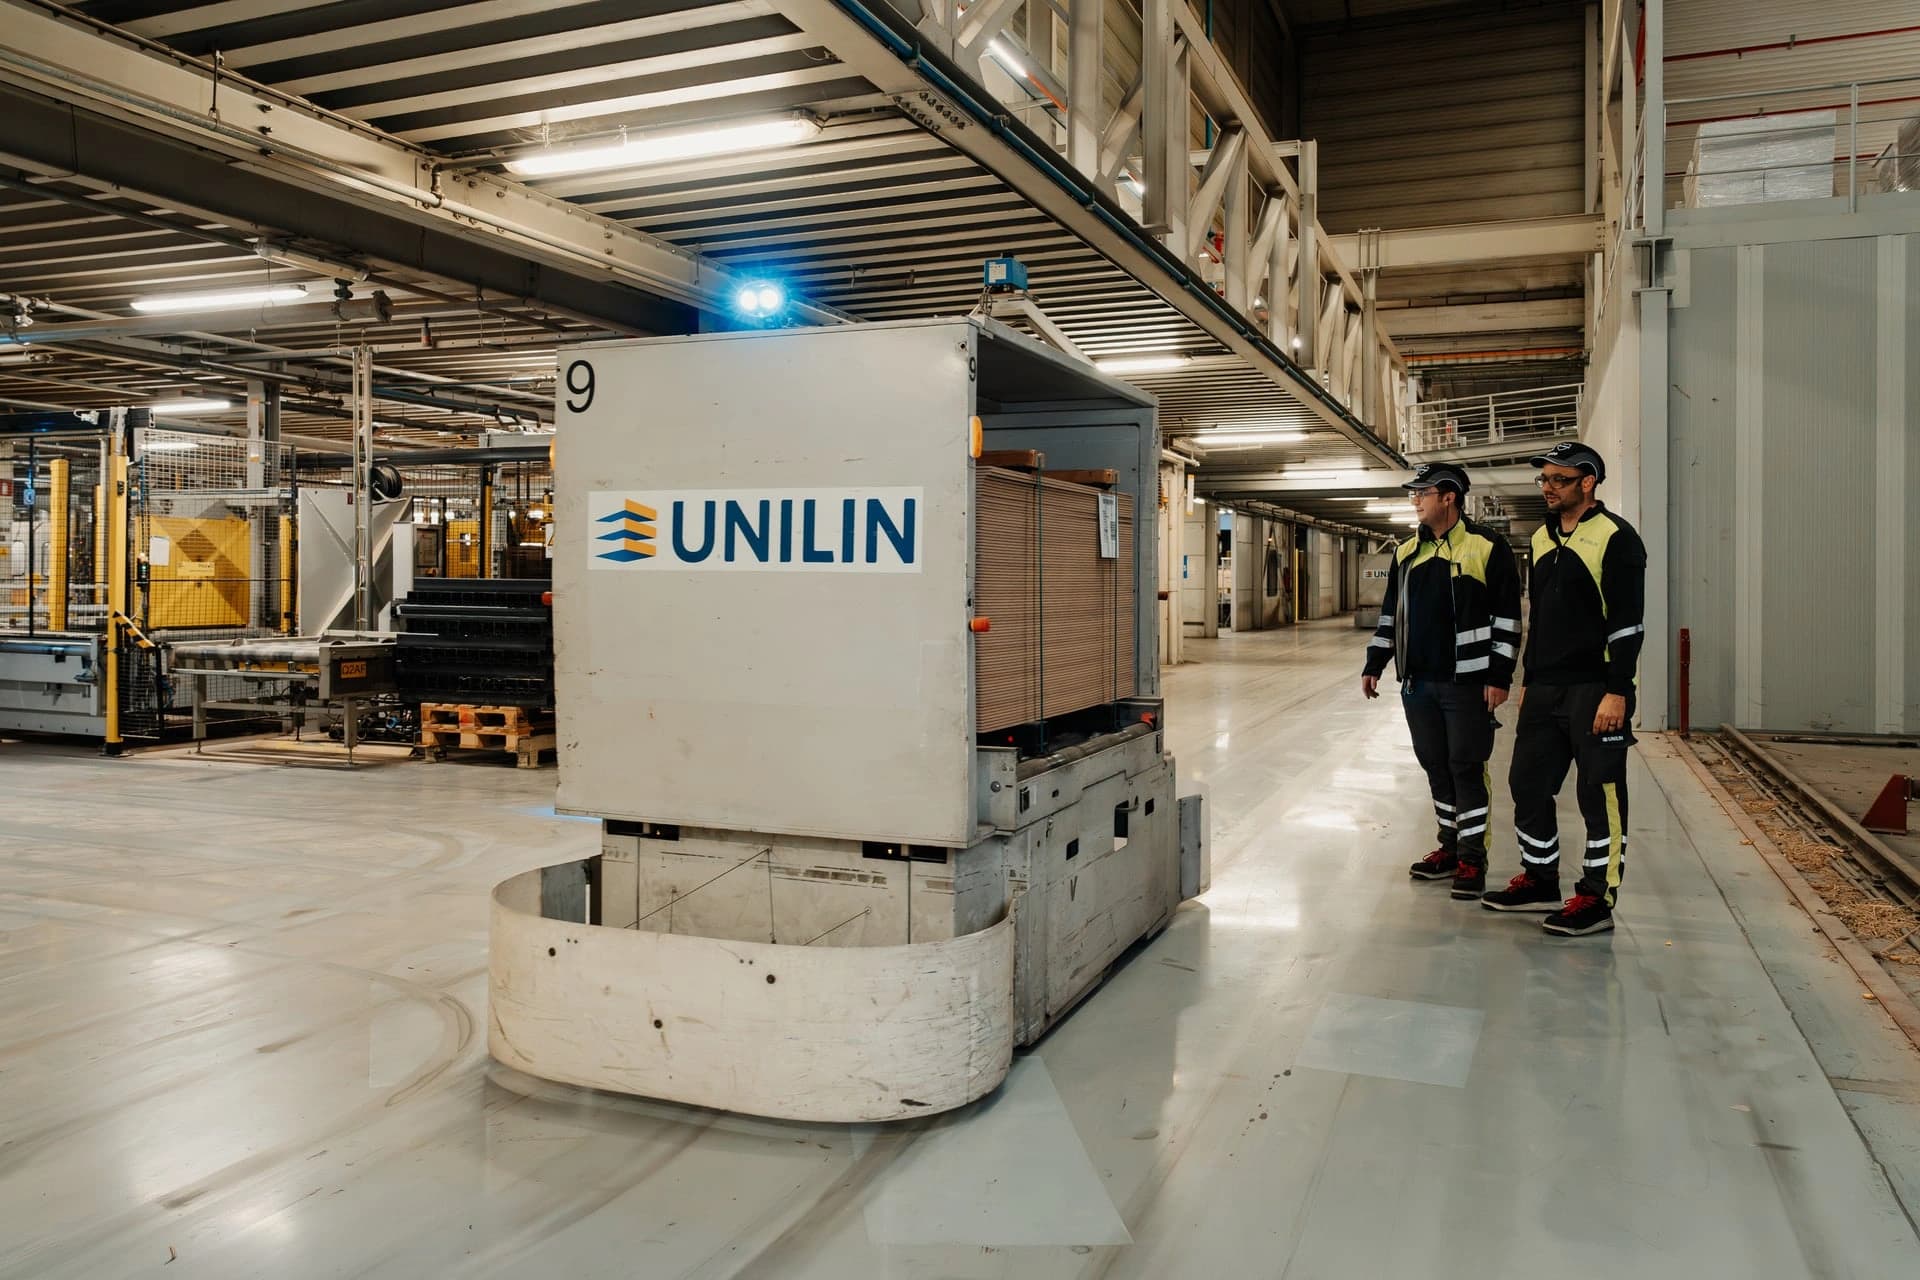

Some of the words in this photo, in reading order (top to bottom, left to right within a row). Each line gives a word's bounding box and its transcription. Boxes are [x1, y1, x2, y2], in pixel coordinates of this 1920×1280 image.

[566, 359, 596, 414] 9
[969, 356, 977, 382] 9
[672, 498, 916, 564] UNILIN
